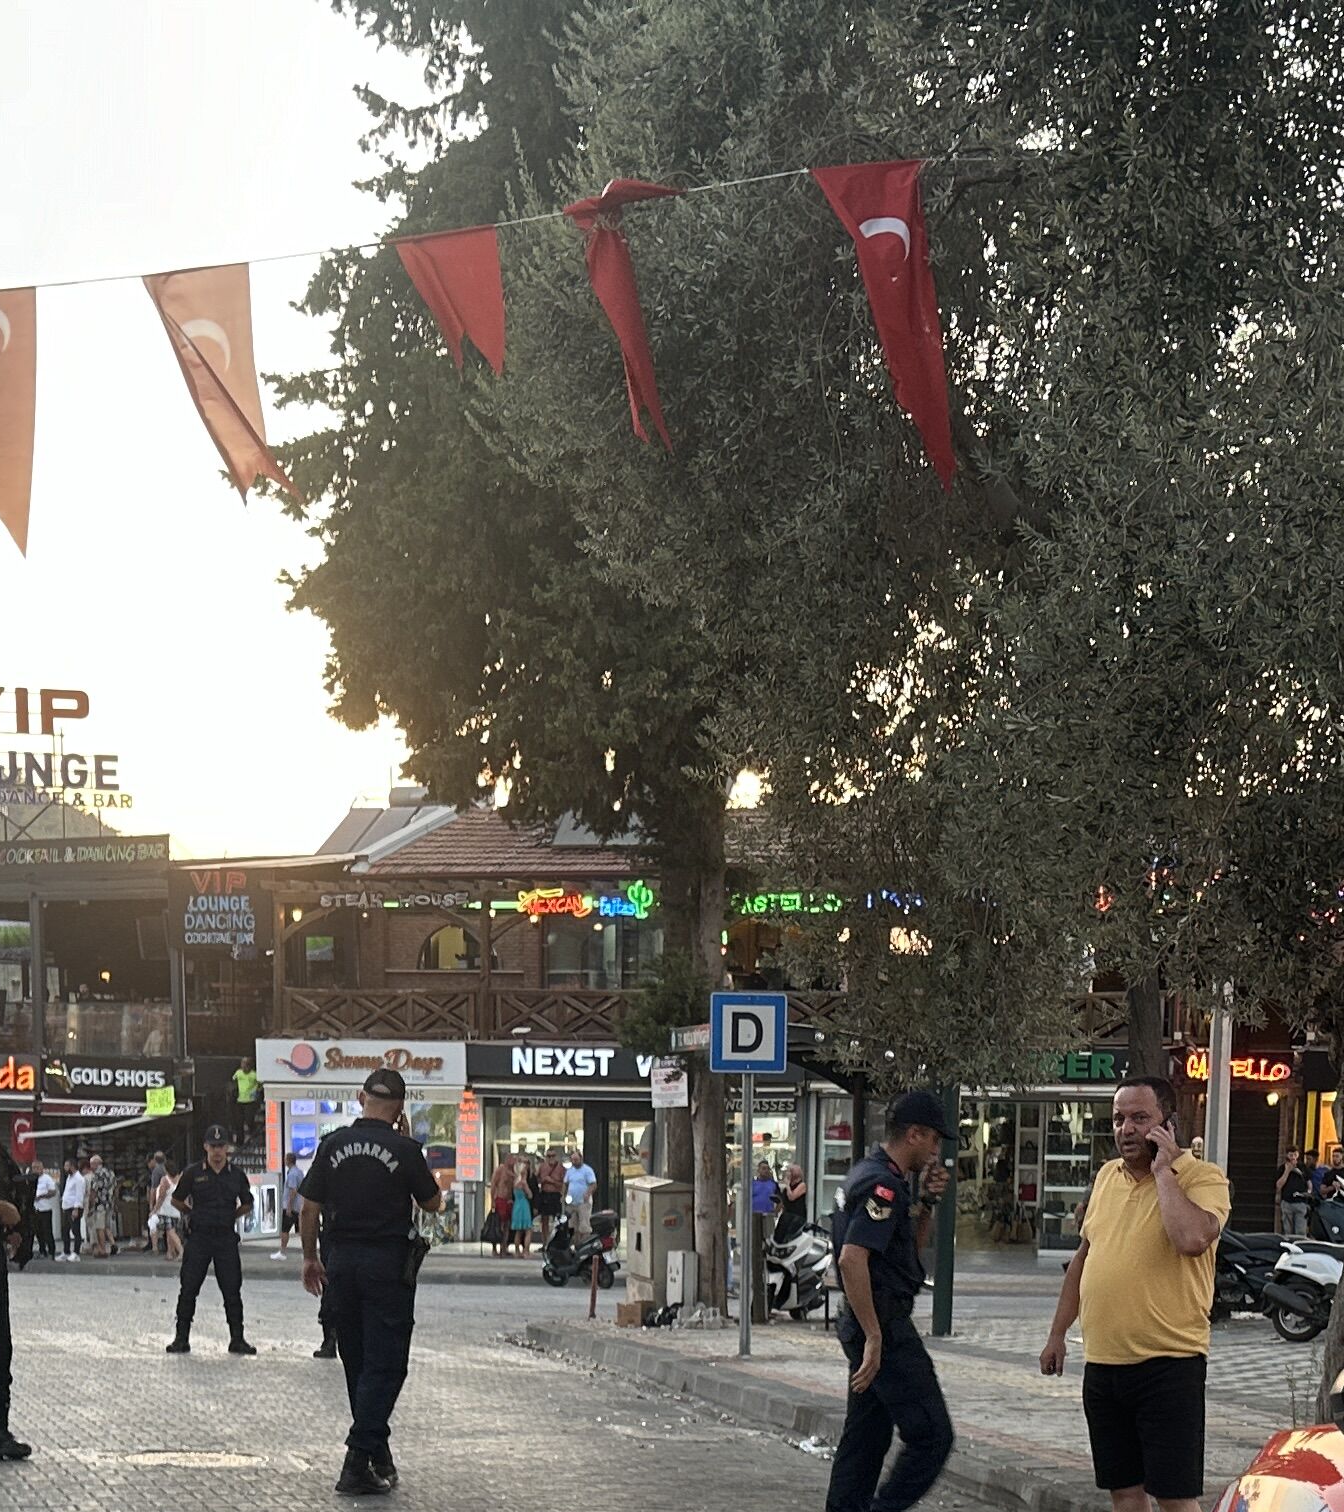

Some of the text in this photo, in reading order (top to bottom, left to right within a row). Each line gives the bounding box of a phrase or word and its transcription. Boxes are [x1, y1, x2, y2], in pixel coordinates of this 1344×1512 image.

[93, 794, 133, 809] BAR
[63, 846, 75, 863] &
[190, 871, 247, 894] VIP
[187, 895, 252, 913] LOUNGE
[320, 891, 470, 908] STEAK HOUSE
[526, 893, 584, 914] MEXICAN
[184, 912, 256, 931] DANCING
[731, 1011, 764, 1054] D
[511, 1047, 615, 1077] NEXST
[1186, 1053, 1291, 1081] CAELLO
[71, 1067, 166, 1088] GOLD SHOES
[307, 1088, 354, 1101] QUALITY
[527, 1096, 571, 1107] SILVER
[80, 1103, 107, 1116] GOLD
[330, 1143, 400, 1174] JANDARMA
